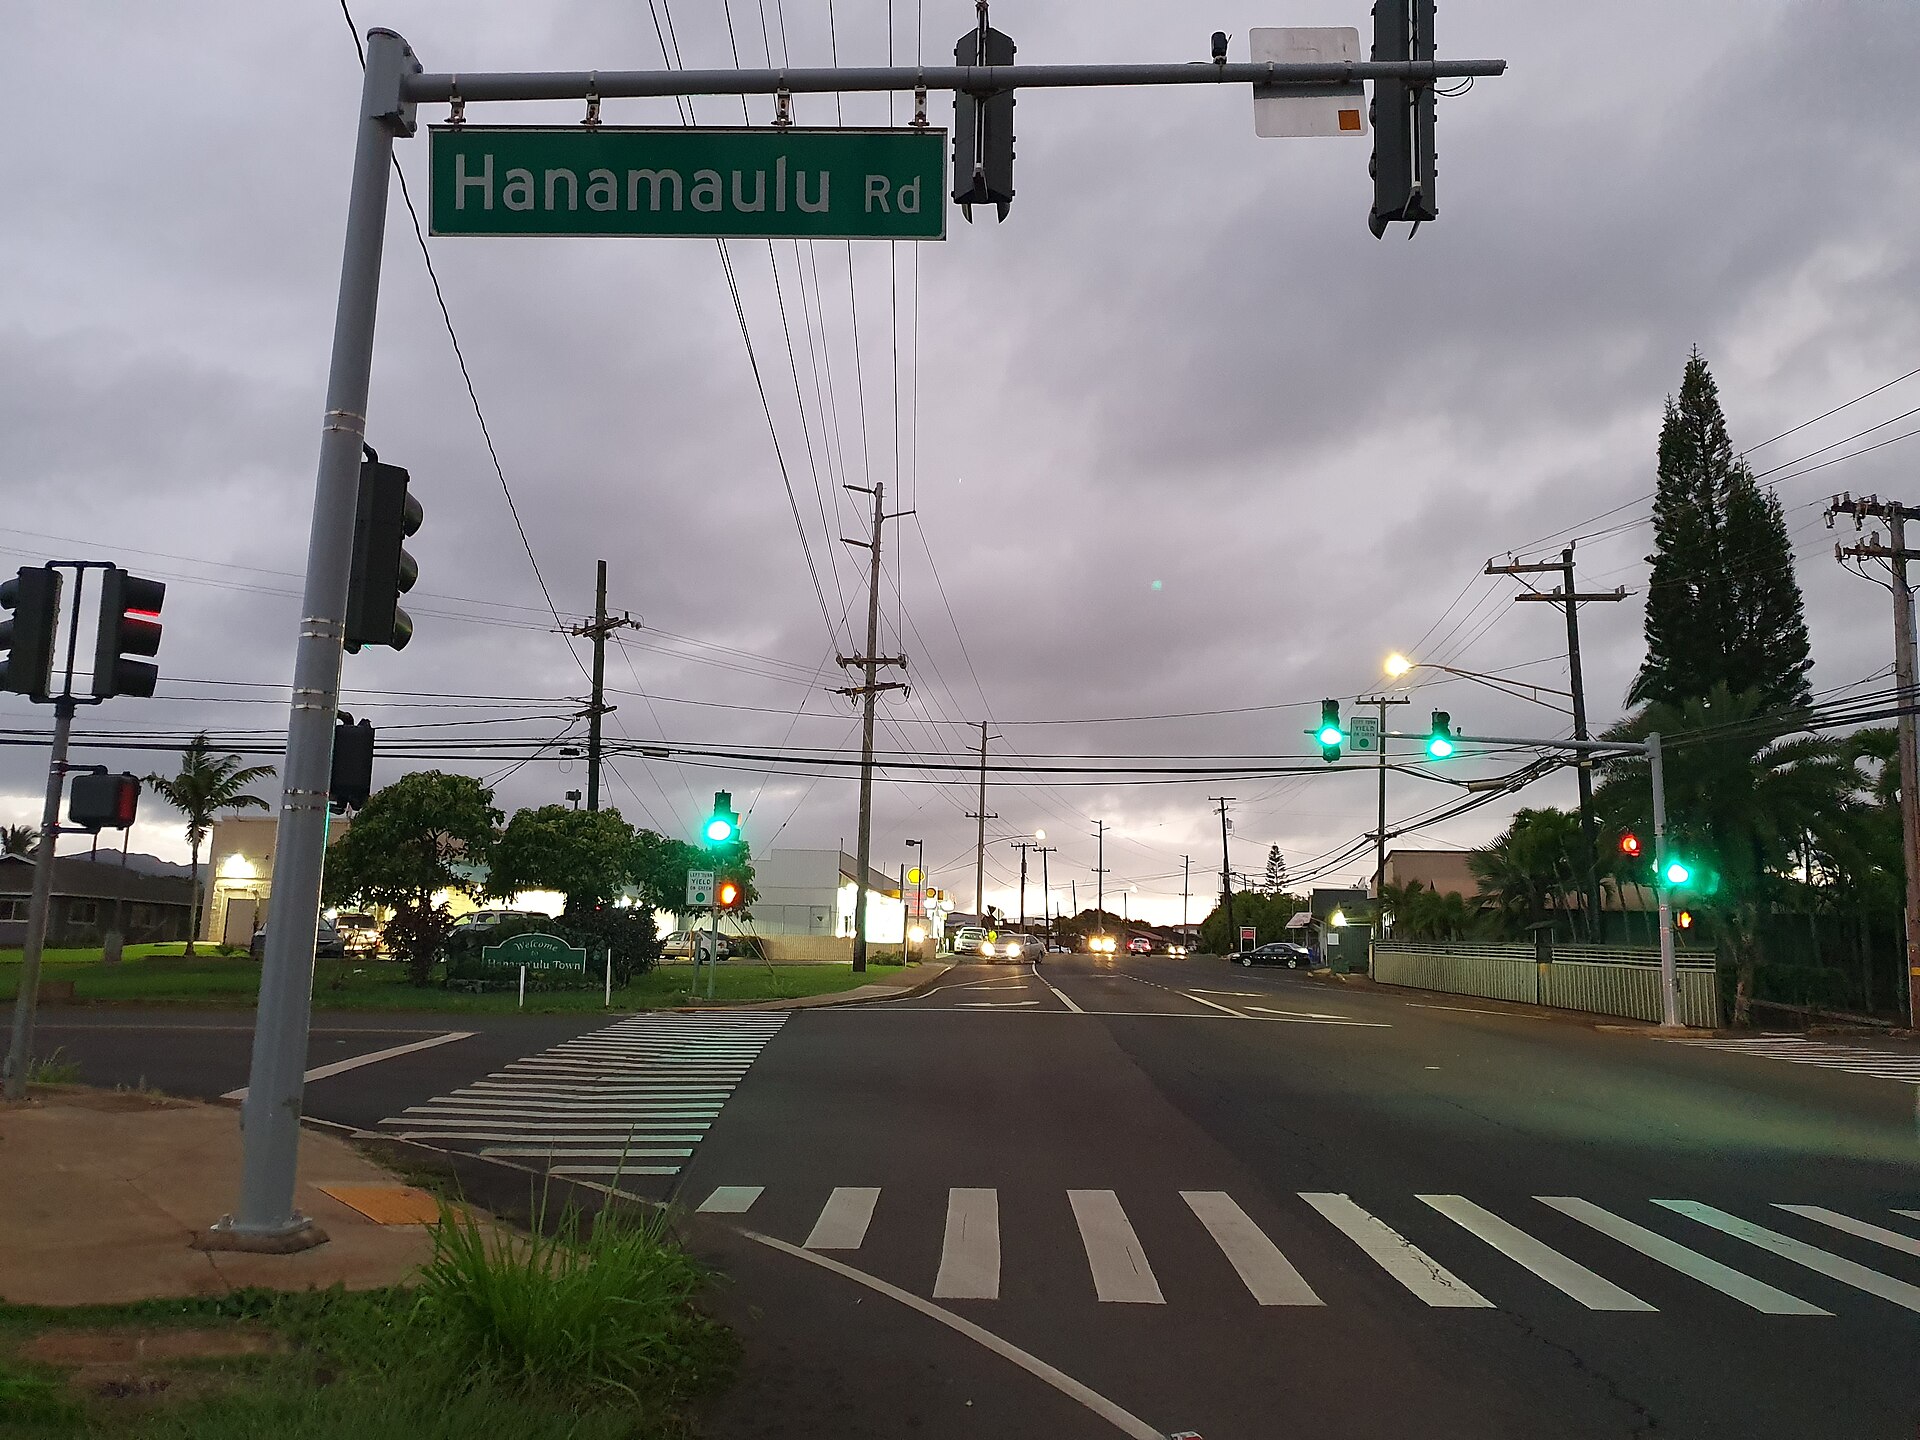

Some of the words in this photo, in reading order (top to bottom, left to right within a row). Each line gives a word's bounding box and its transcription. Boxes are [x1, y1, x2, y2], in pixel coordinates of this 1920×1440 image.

[454, 153, 830, 213] Hanamaulu
[864, 173, 921, 214] Rd
[513, 939, 558, 952] Welcome
[553, 960, 581, 970] Town
